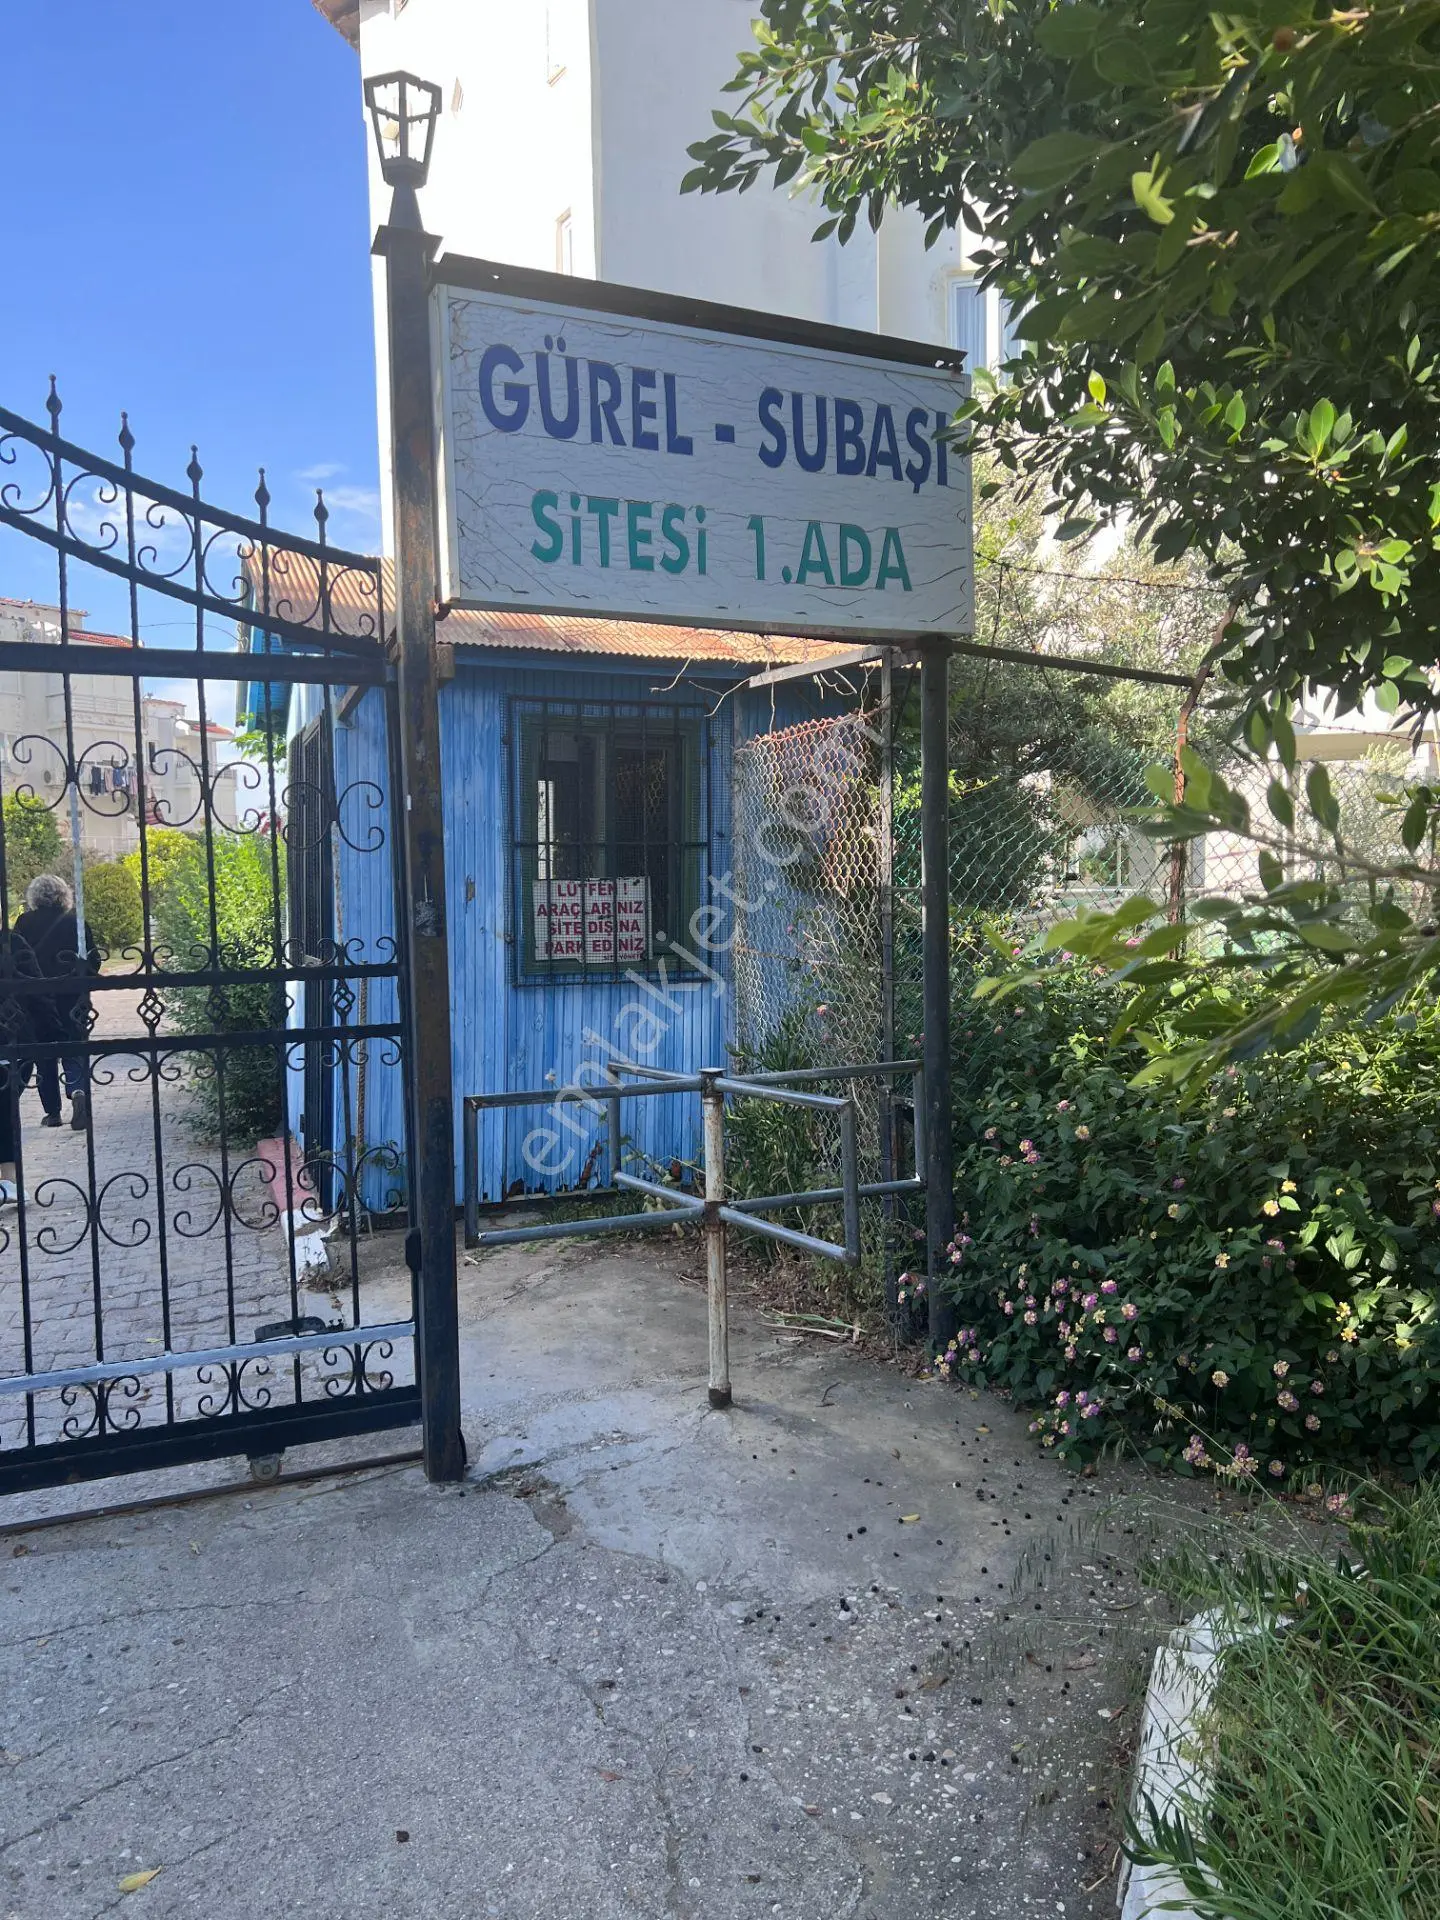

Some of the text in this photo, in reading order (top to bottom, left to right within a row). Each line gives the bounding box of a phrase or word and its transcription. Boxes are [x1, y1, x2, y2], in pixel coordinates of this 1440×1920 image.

[479, 334, 949, 494] GÜREL - SUBAŞI
[746, 515, 912, 592] 1.ADA
[588, 919, 641, 936] DIŞNA
[592, 935, 644, 952] EDNİZ
